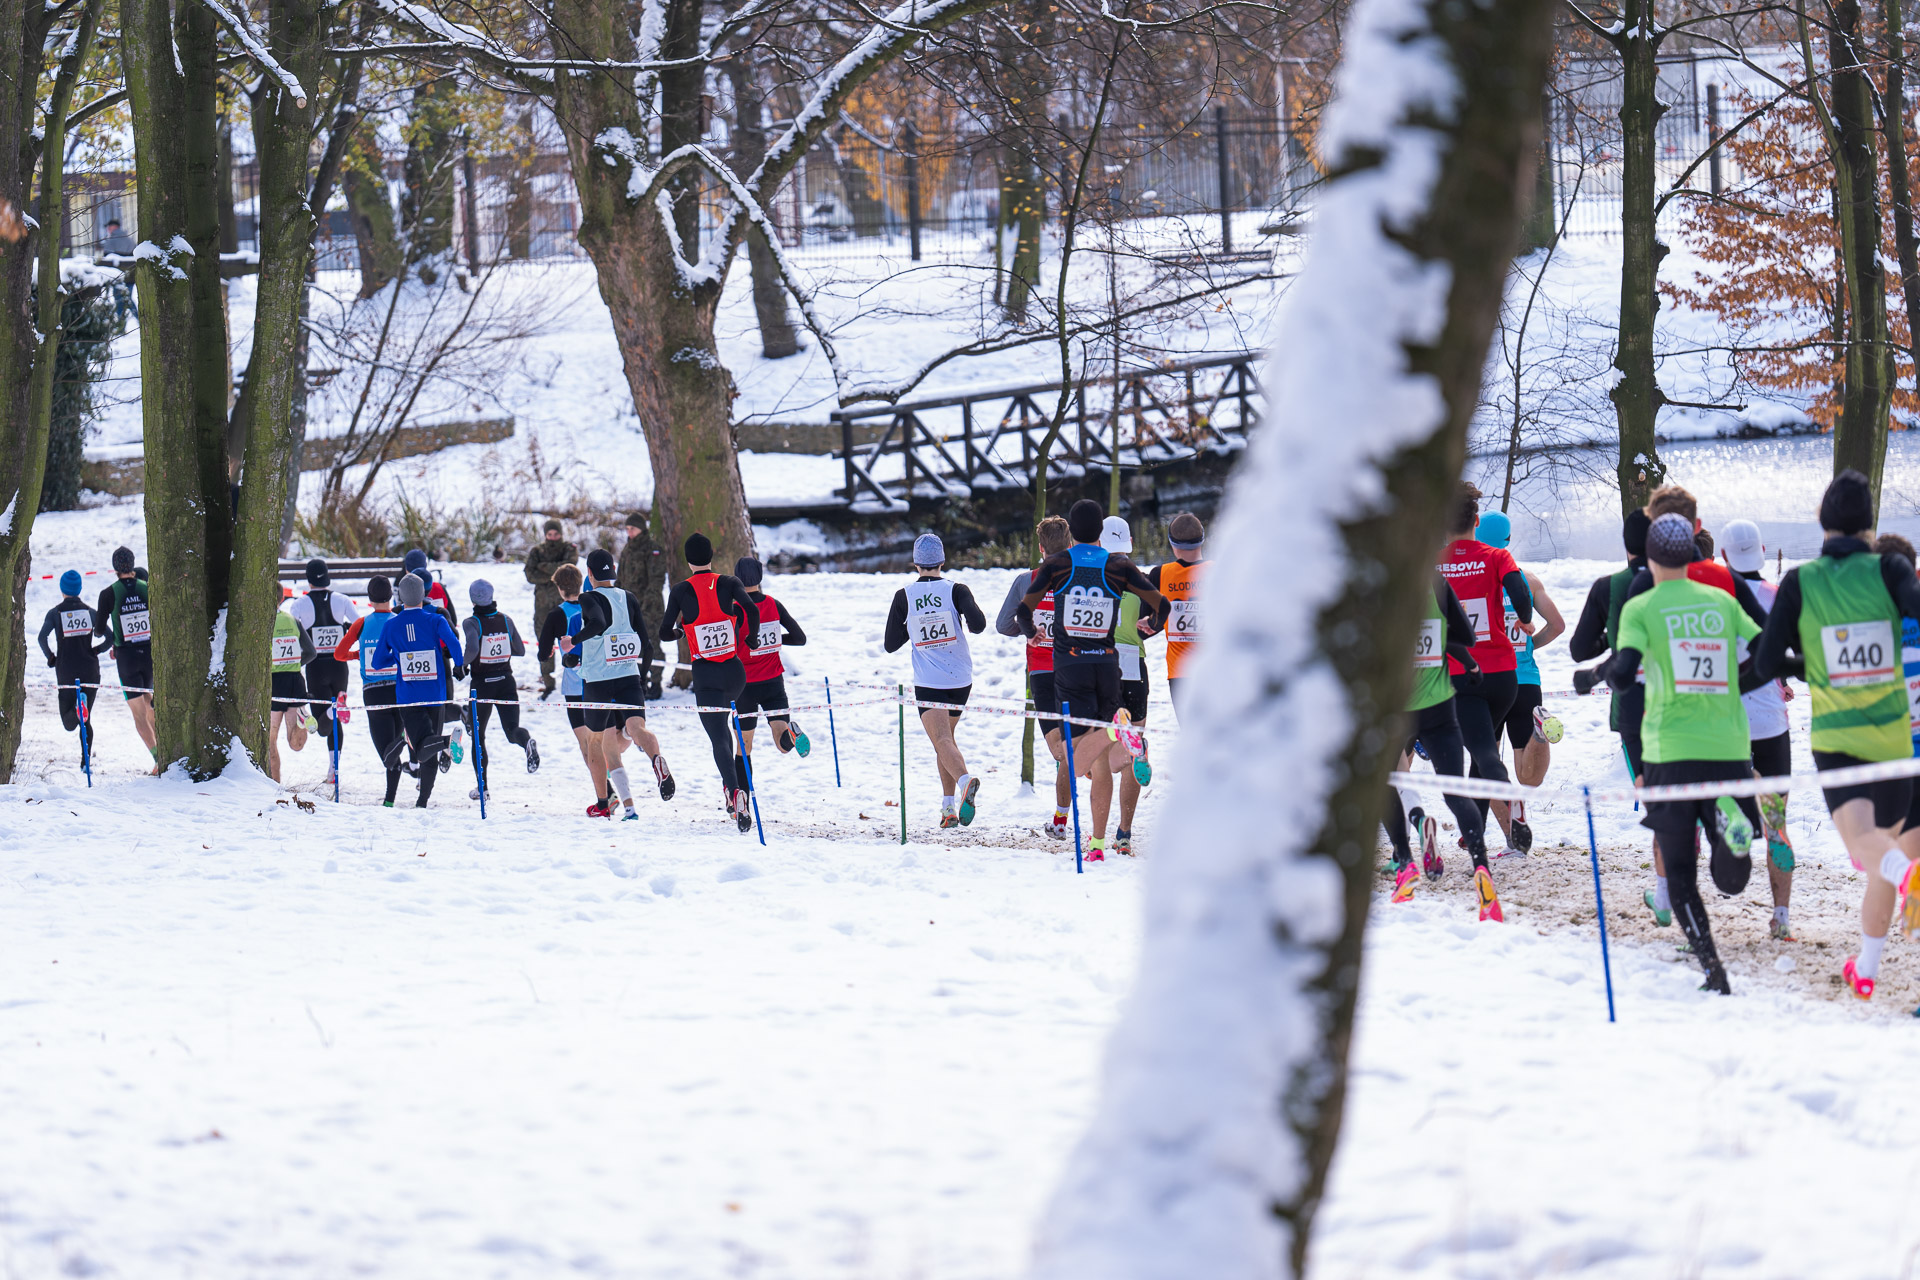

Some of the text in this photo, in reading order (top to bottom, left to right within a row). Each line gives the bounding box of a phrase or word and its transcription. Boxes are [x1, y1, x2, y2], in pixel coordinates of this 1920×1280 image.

[1435, 561, 1486, 573] RESOVIA
[1168, 582, 1201, 593] SŁODK
[125, 595, 141, 603] AML
[915, 593, 942, 611] RKS
[67, 618, 88, 630] 496
[1071, 609, 1104, 628] 528
[1665, 609, 1725, 640] PRO
[127, 620, 148, 634] 390
[708, 624, 728, 633] FUEL
[920, 623, 949, 641] 164
[317, 635, 339, 647] 237
[703, 632, 730, 649] 212
[280, 645, 294, 658] 74
[490, 643, 503, 657] 63
[611, 642, 636, 657] 509
[1838, 643, 1884, 670] 440
[406, 660, 431, 674] 498
[1689, 656, 1714, 679] 73
